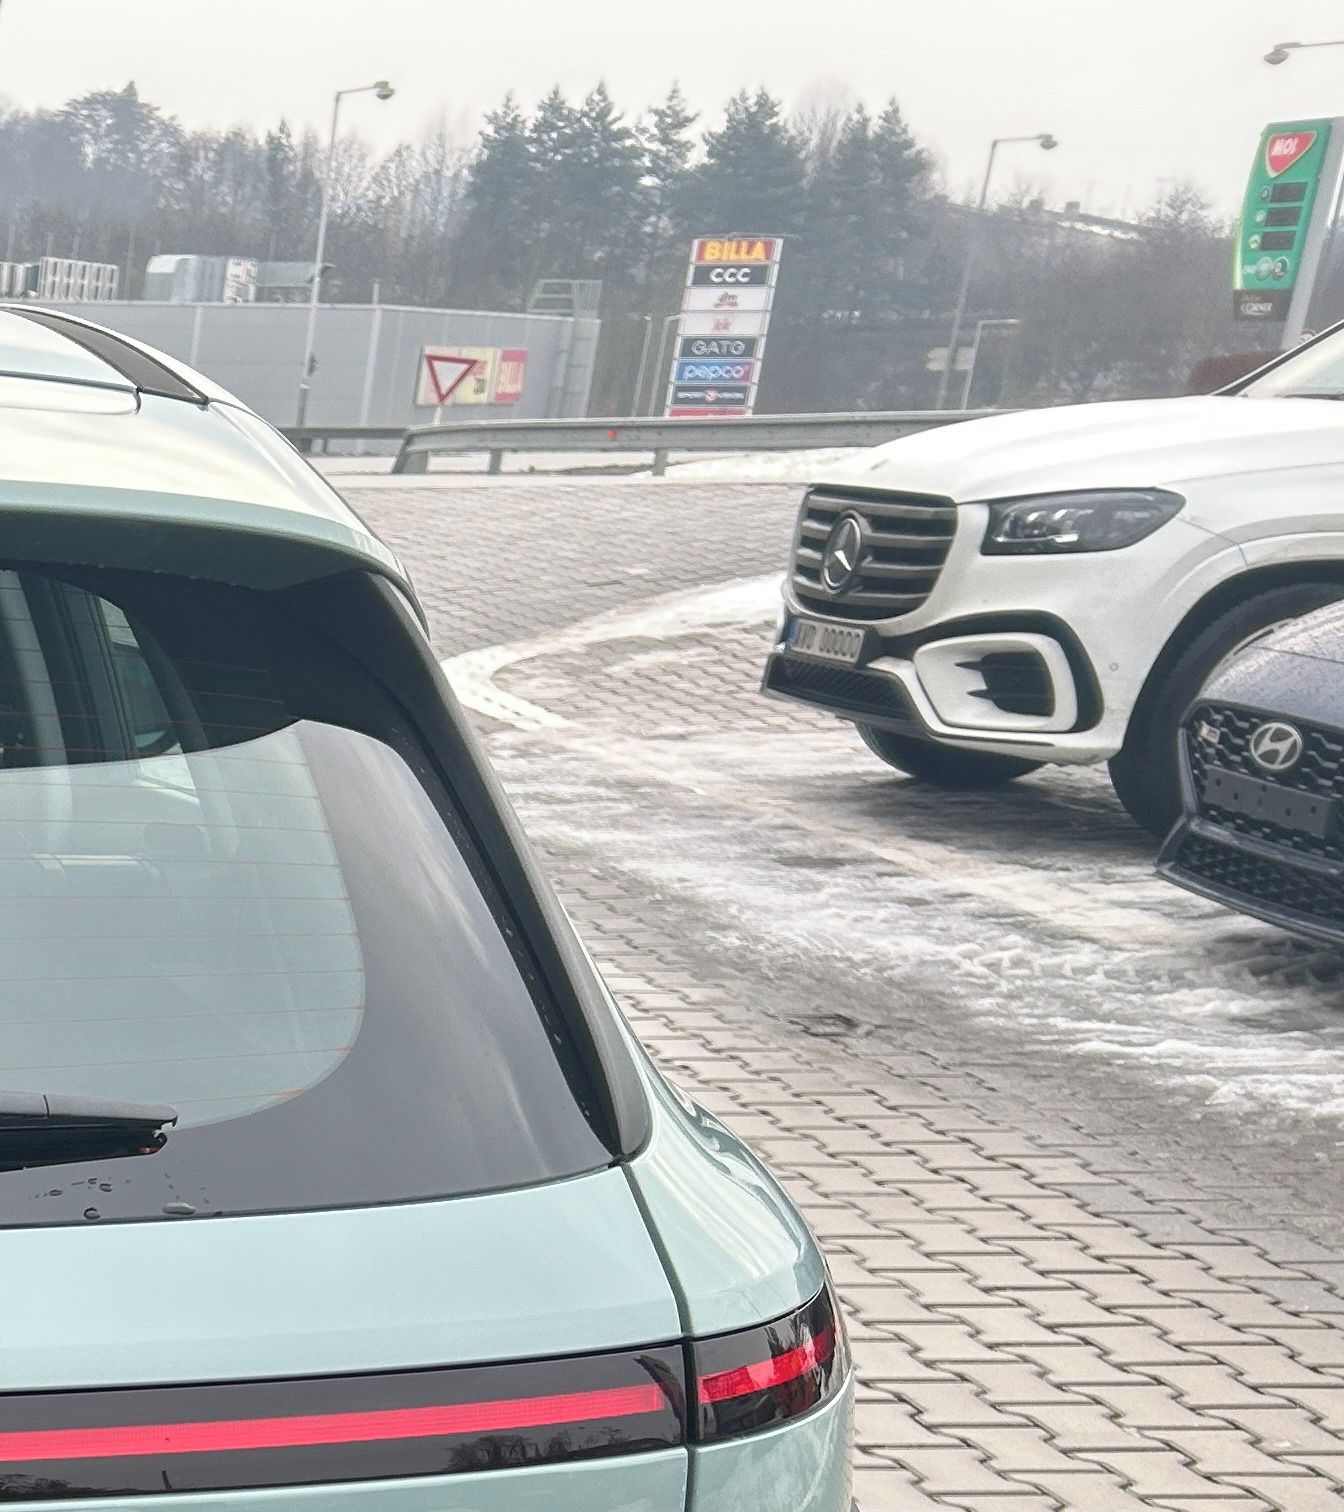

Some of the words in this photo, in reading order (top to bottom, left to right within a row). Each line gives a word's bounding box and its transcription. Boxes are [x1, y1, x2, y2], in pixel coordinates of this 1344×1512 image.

[703, 240, 766, 261] BILLA
[709, 267, 752, 283] CCC
[683, 365, 745, 381] pepco
